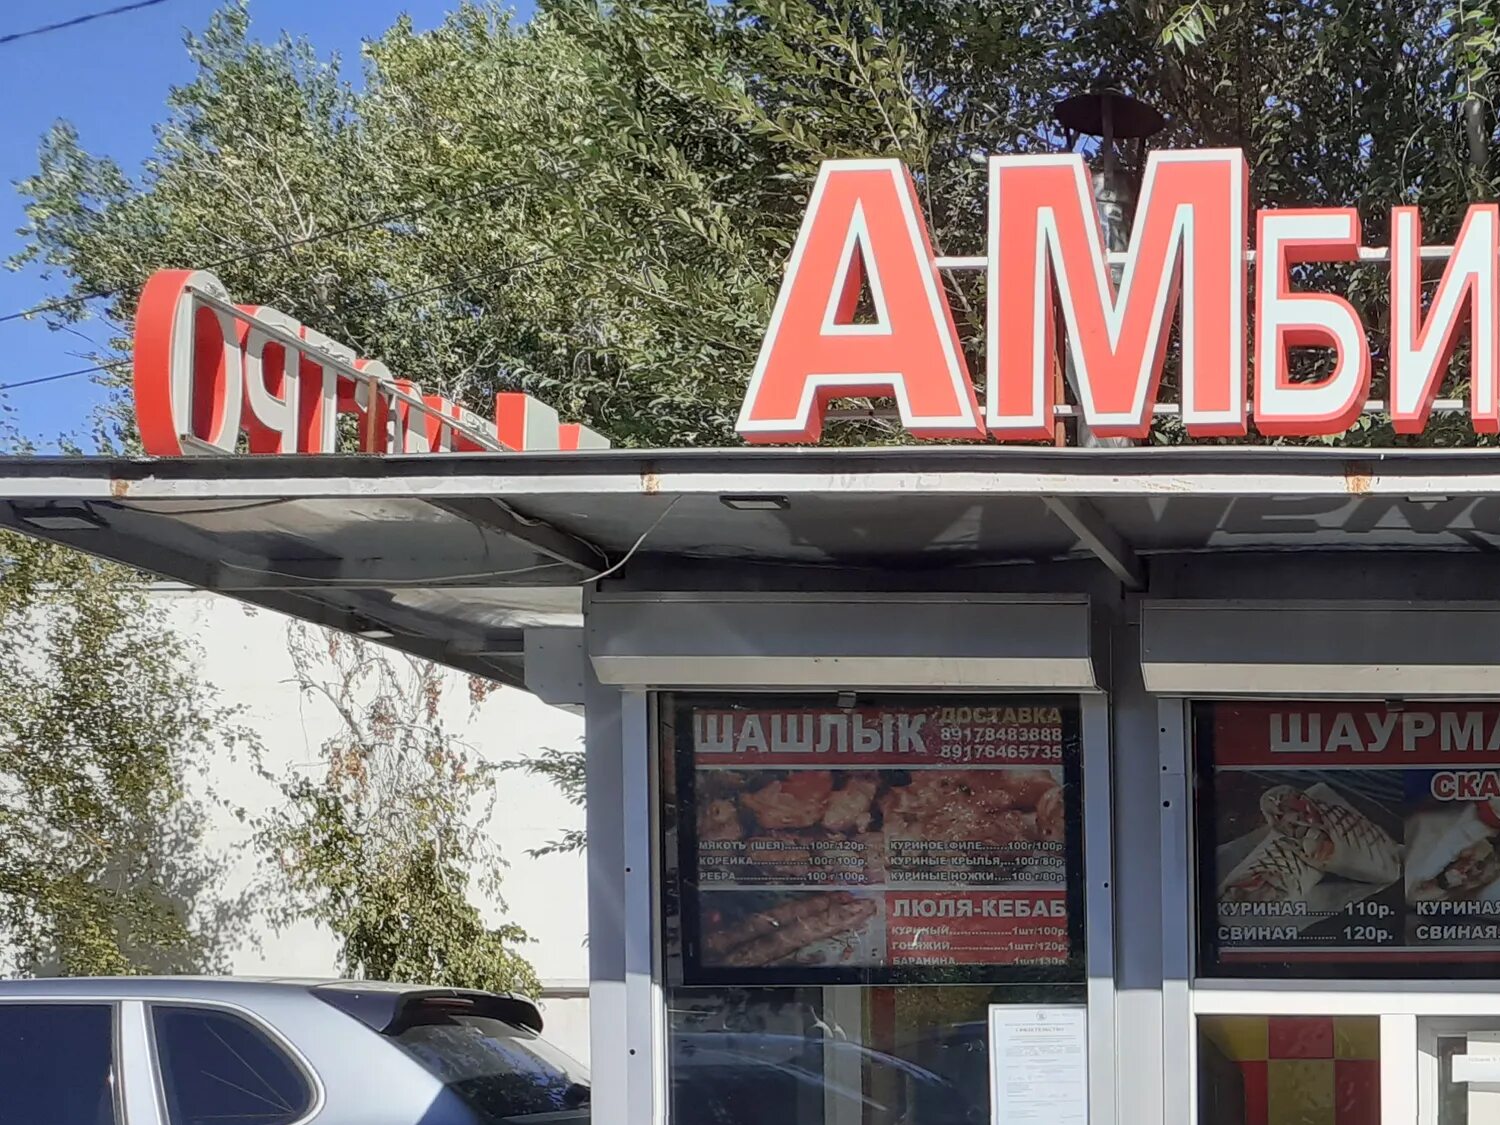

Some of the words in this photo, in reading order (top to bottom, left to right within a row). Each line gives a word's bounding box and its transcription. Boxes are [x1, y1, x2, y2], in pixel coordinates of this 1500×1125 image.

[940, 707, 1062, 724] ДОСТАВКА
[694, 714, 927, 754] ШАШЛЫК
[699, 841, 747, 850] МЯКОТЬ
[890, 841, 945, 850] КУРИНОЕ
[949, 841, 983, 850] ФИЛЕ
[890, 857, 947, 866] КУРИНЫЕ
[951, 857, 1001, 866] КРЫЛЬЯ
[700, 871, 736, 881] РЕБРА
[890, 872, 947, 881] КУРИНЫЕ
[950, 872, 995, 881] НОЖКИ
[893, 900, 1067, 918] ЛЮЛЯ-КЕБАБ
[1217, 901, 1307, 917] КУРИНАЯ
[1344, 902, 1395, 918] 110р.
[1217, 926, 1299, 940] СВИНАЯ
[1343, 926, 1393, 943] 120р.
[1416, 925, 1498, 940] СВИНАЯ
